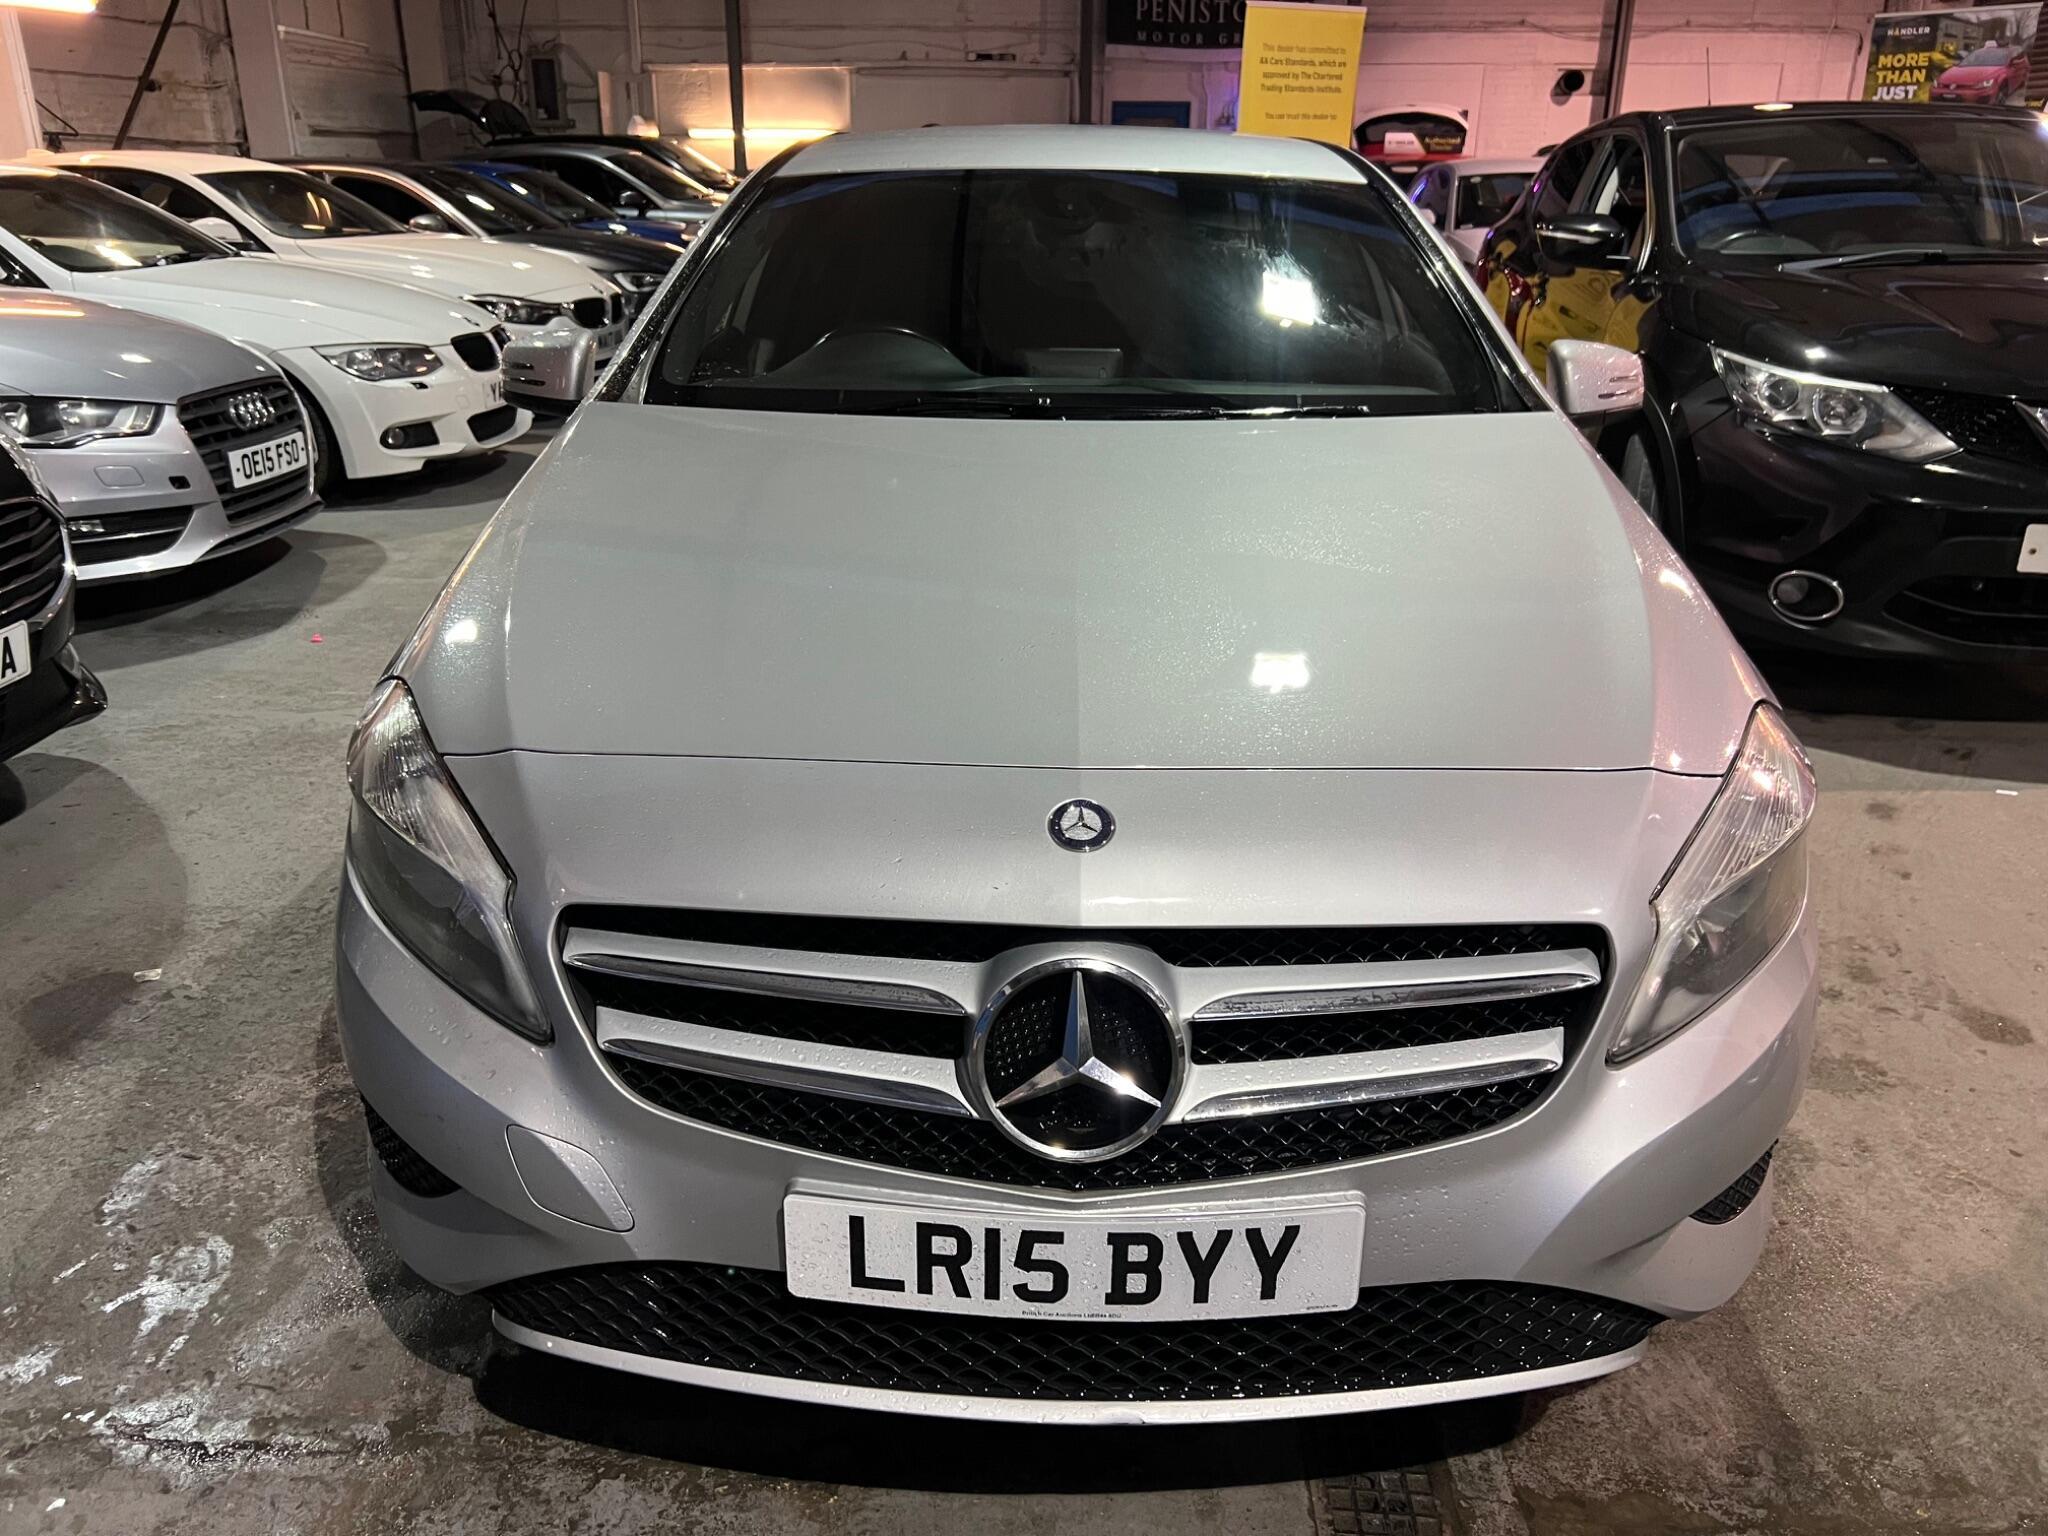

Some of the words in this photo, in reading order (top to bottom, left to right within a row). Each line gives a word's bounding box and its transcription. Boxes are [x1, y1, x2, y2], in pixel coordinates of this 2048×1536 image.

[1137, 31, 1204, 45] MOTOR
[1269, 57, 1284, 66] Cars
[1318, 58, 1337, 67] which
[1878, 52, 1930, 68] MORE
[1312, 72, 1343, 81] Chartered
[1876, 69, 1926, 84] THAN
[1260, 83, 1283, 93] Trading
[1284, 84, 1314, 93] Standards
[1872, 85, 1918, 100] JUST
[241, 447, 275, 480] OE15
[848, 1214, 1069, 1304] LR15
[1104, 1224, 1301, 1306] BYY
